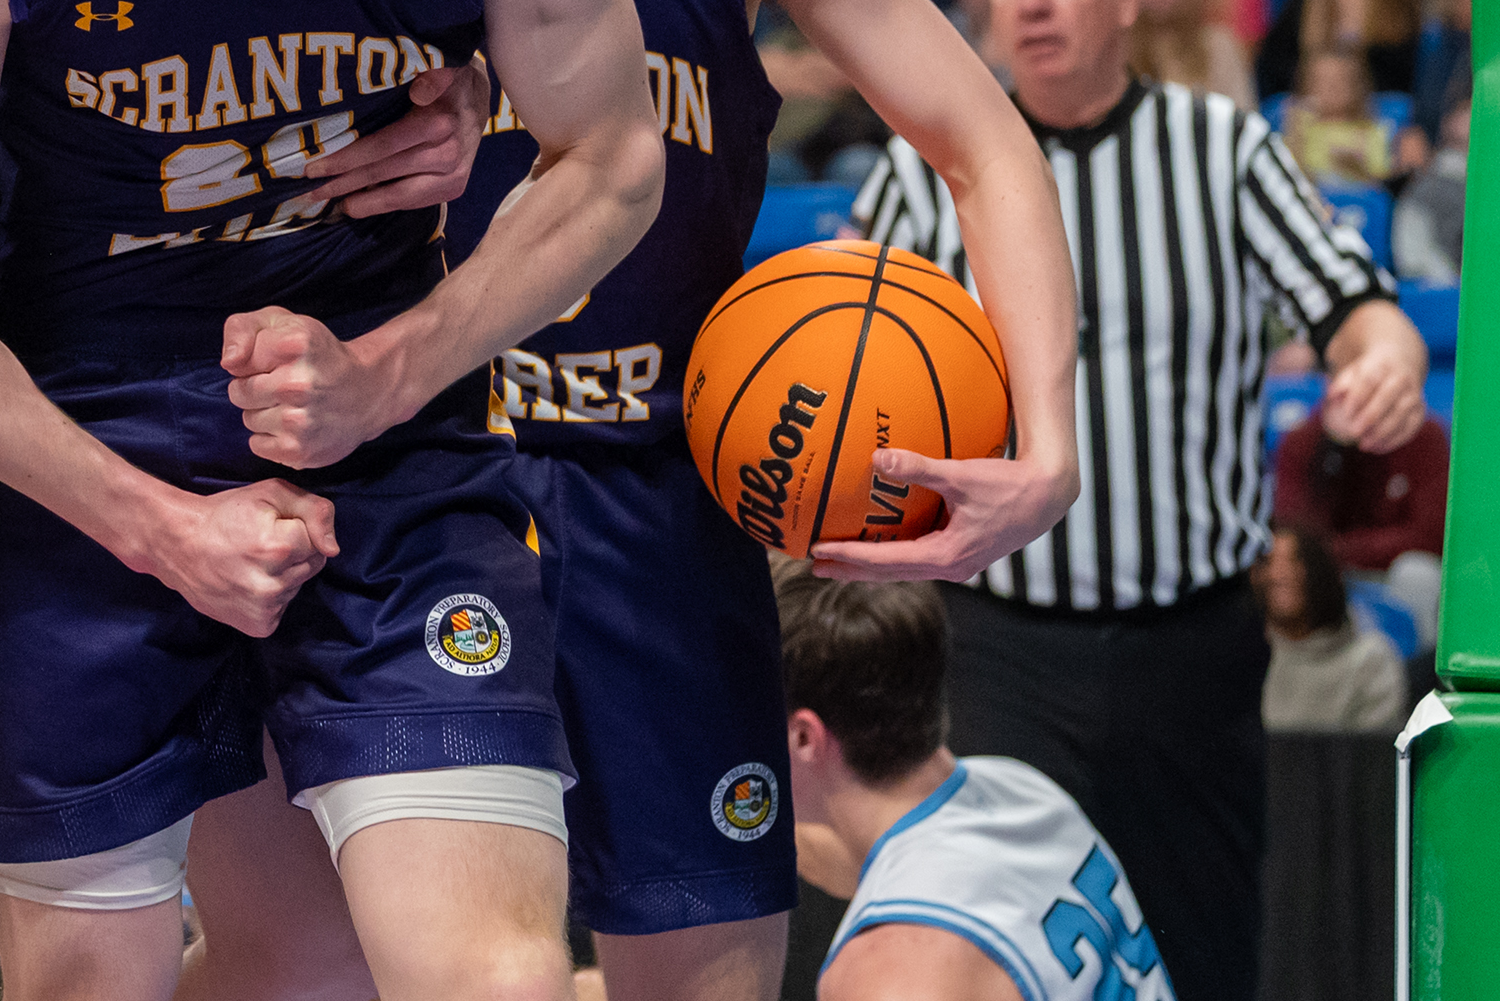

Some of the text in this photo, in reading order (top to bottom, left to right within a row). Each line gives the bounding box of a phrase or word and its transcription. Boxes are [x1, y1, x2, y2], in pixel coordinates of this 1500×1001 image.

[65, 32, 444, 133] SCRANTON
[502, 342, 663, 422] REP
[736, 382, 828, 549] Wilson
[877, 408, 890, 448] NXT
[427, 595, 510, 669] SCRANTON PREPARATORY SCHOOL
[465, 662, 496, 674] 1944
